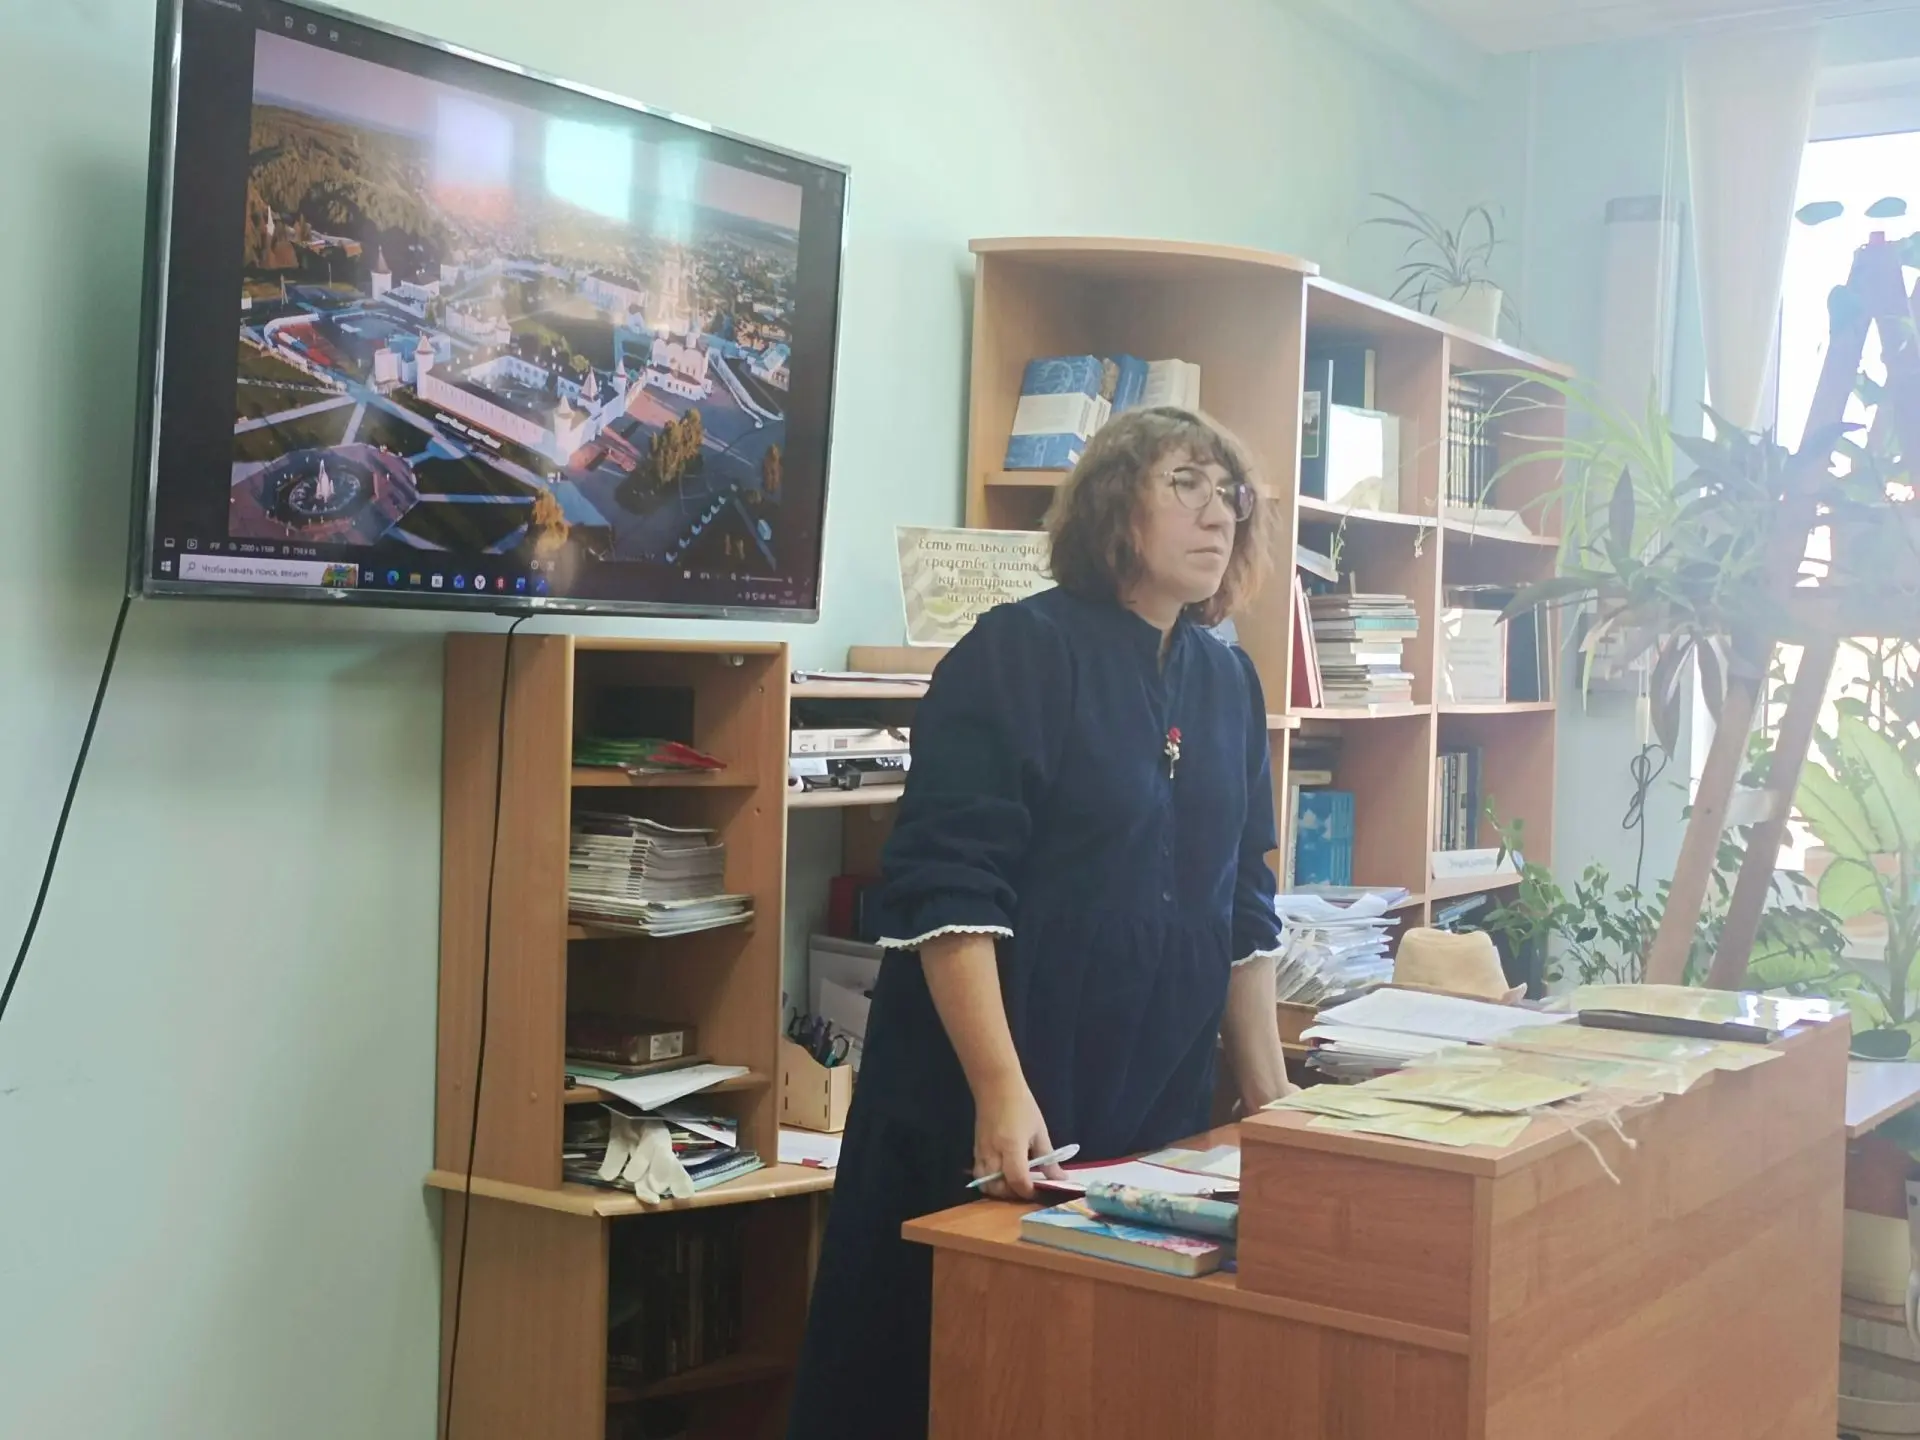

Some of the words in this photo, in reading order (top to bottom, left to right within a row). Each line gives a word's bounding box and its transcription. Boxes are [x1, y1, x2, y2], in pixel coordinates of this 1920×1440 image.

[918, 537, 952, 551] Есть
[955, 542, 1008, 554] только
[924, 556, 989, 572] средство
[992, 561, 1041, 573] стать
[938, 575, 1033, 590] культурным
